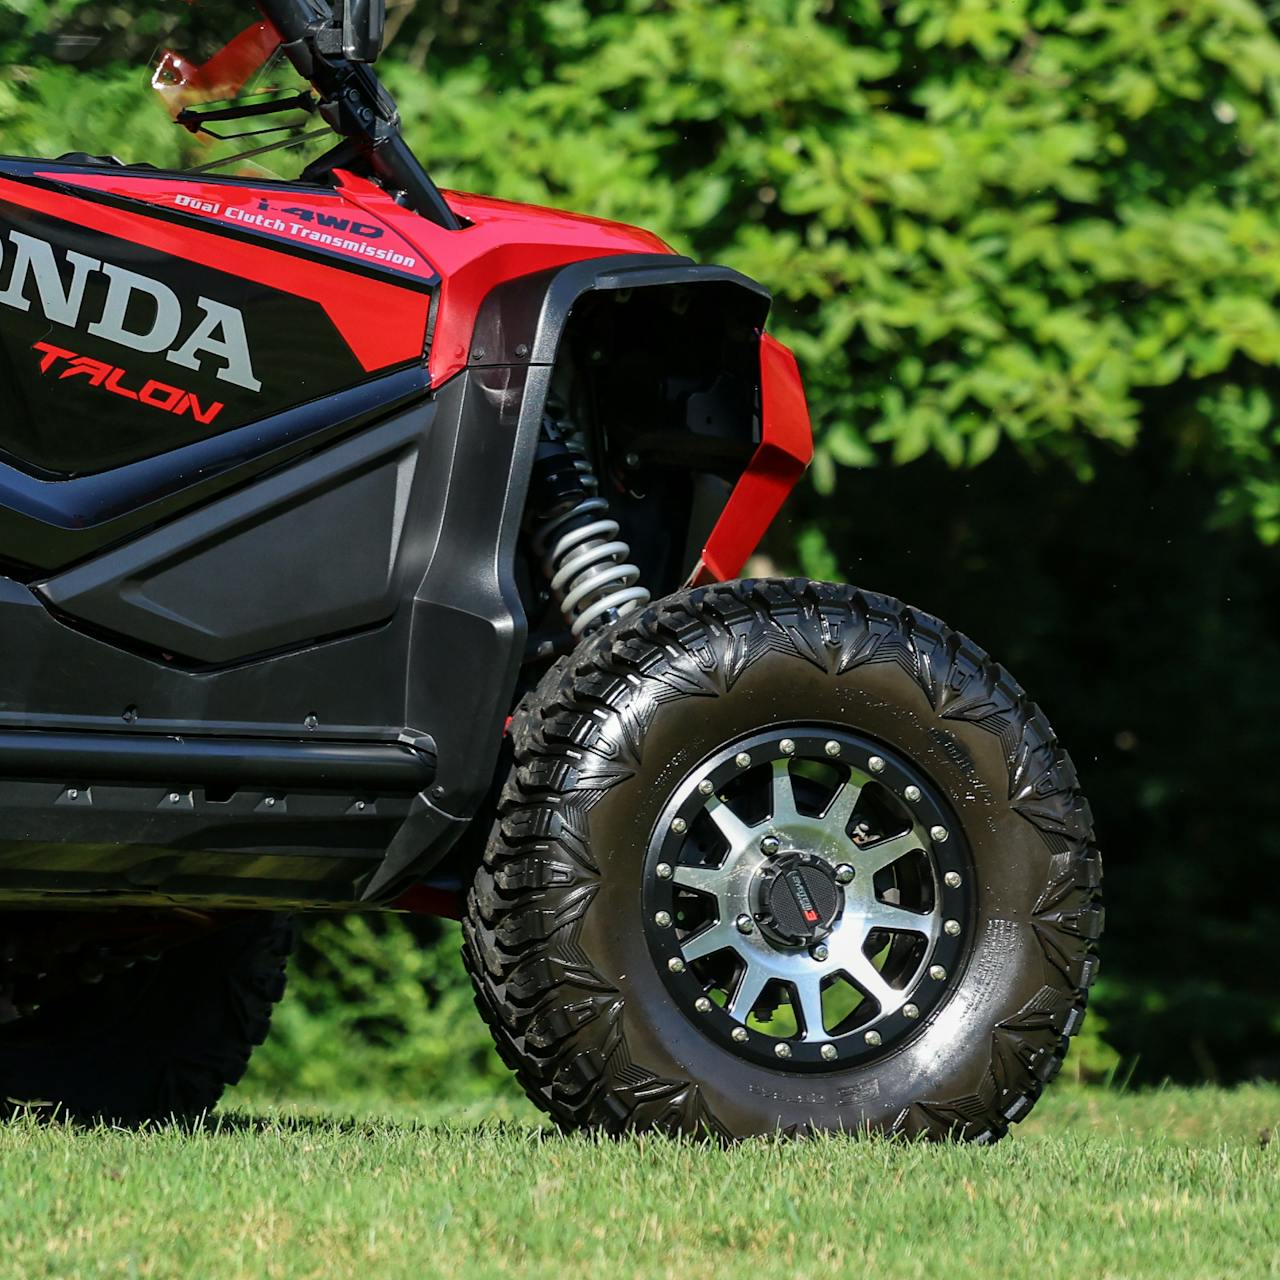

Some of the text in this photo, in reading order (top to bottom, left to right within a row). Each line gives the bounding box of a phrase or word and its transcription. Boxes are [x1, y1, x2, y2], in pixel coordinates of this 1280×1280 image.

[173, 194, 416, 268] Dual Clutch Transmission
[257, 198, 384, 239] i-4WD
[32, 341, 224, 425] TALON
